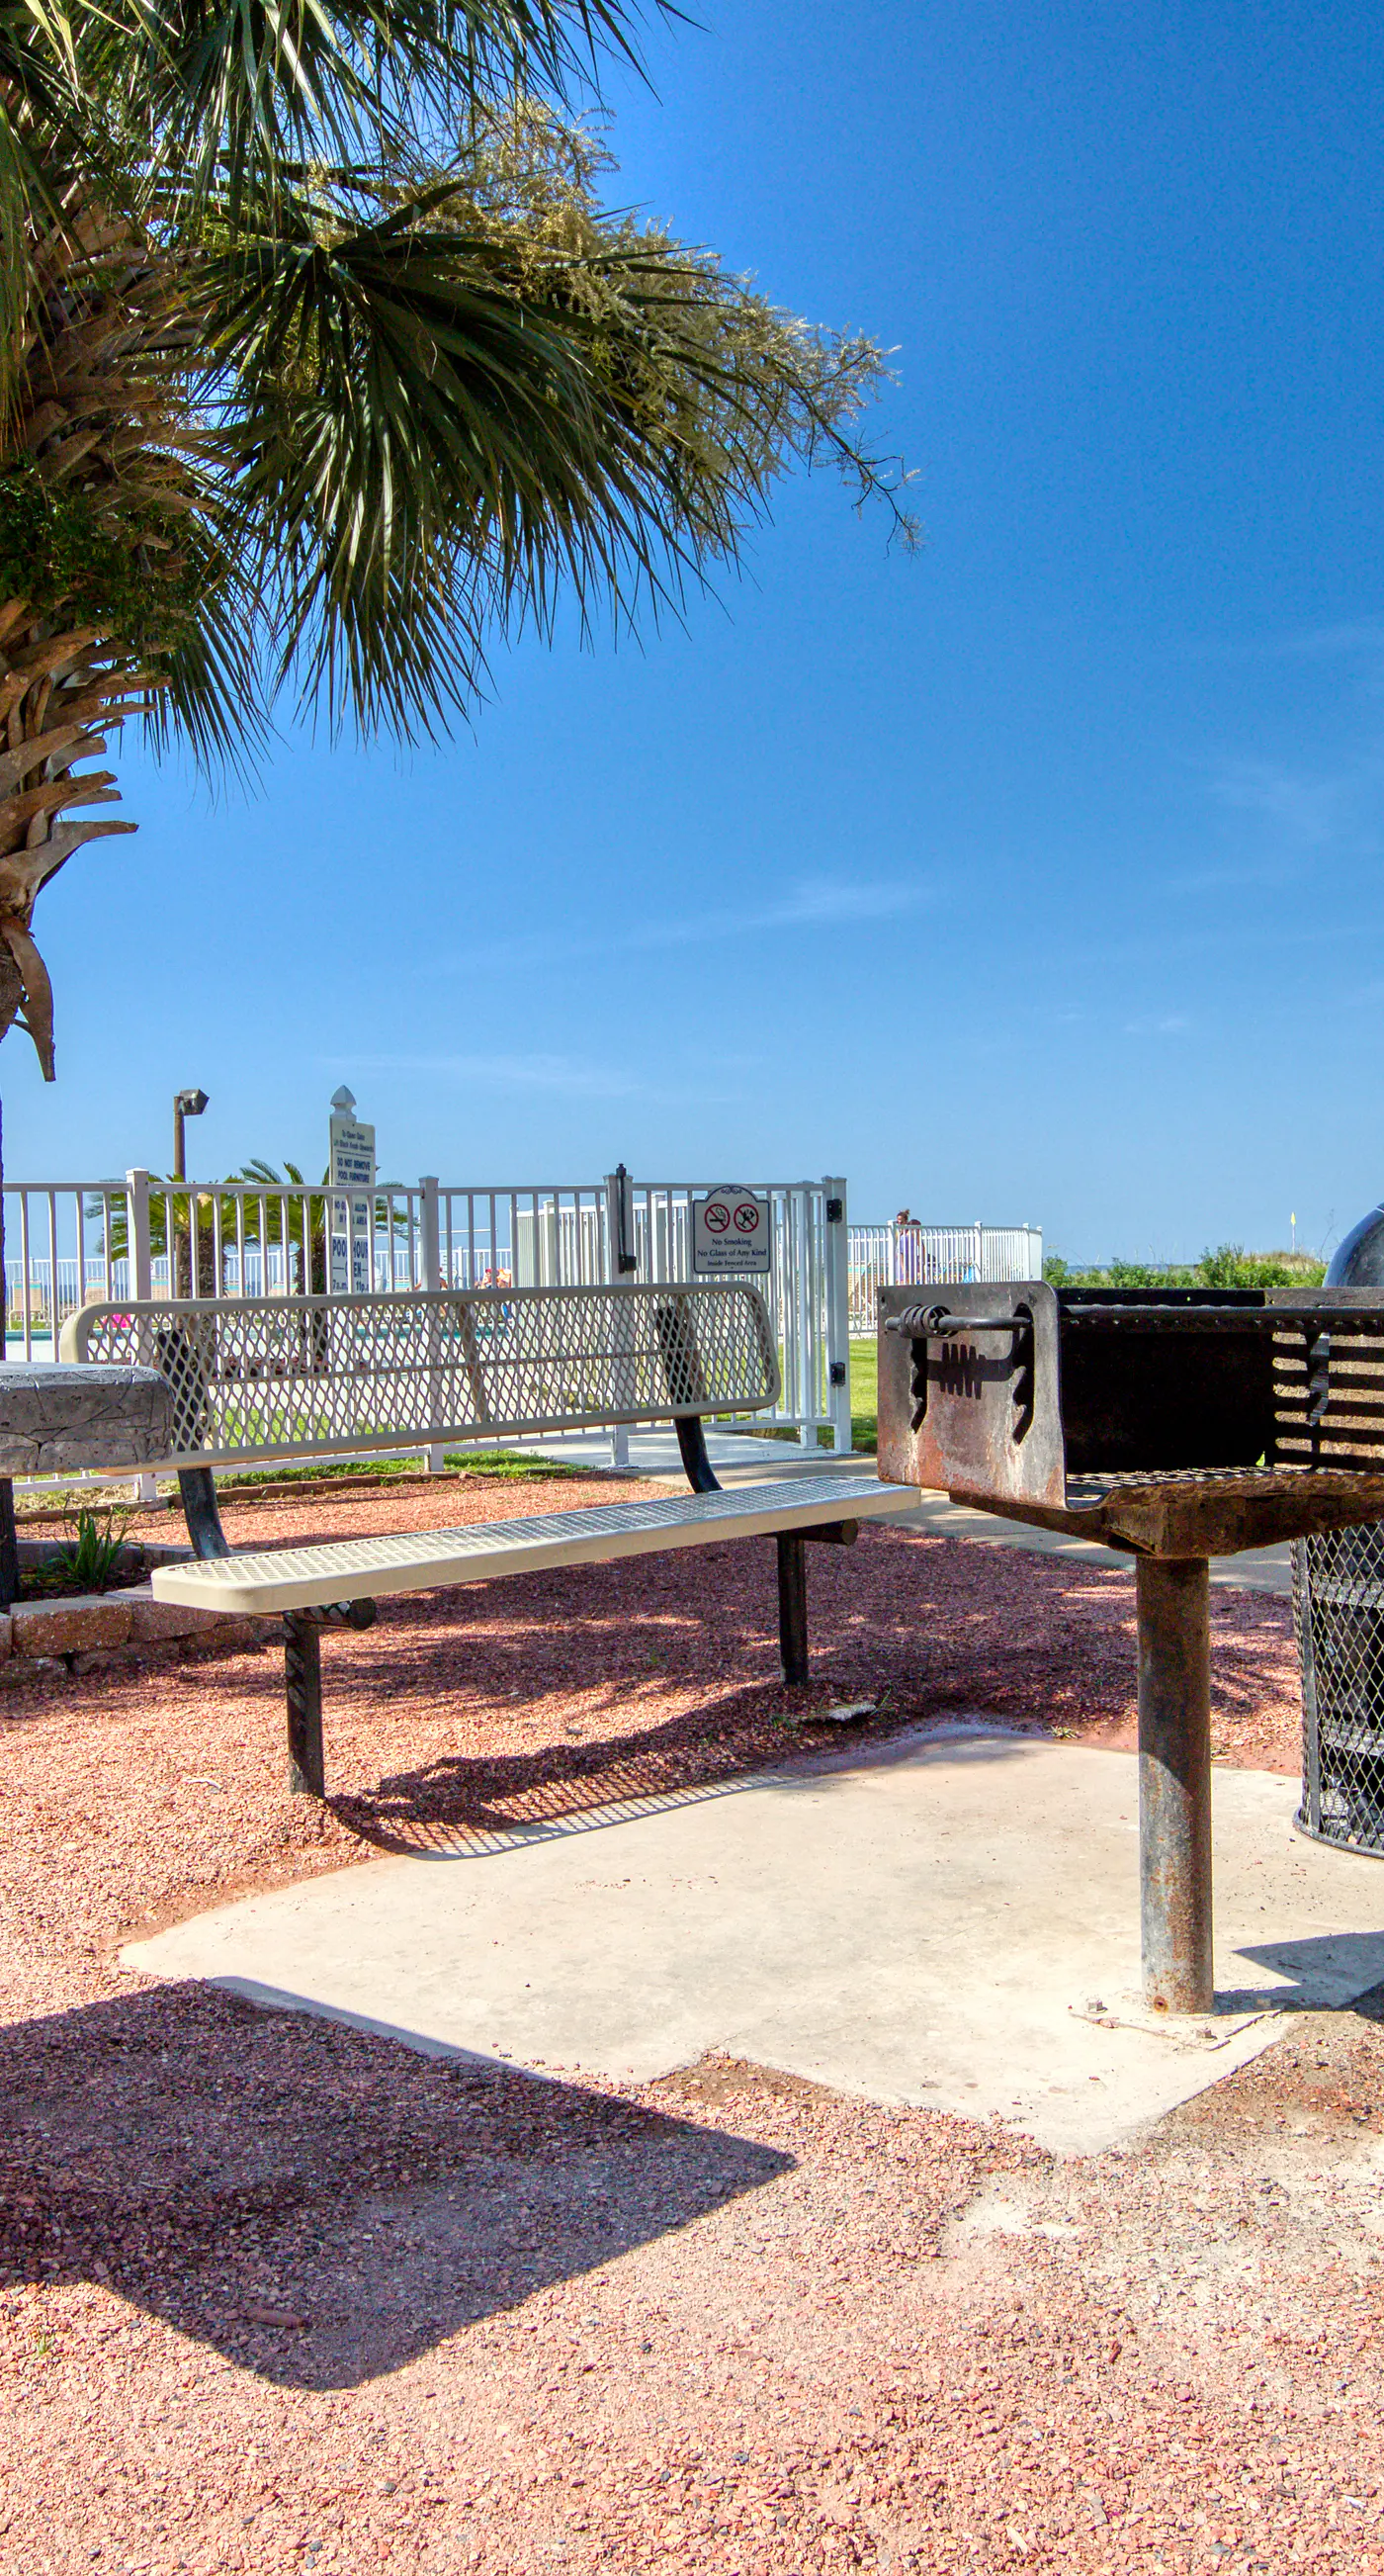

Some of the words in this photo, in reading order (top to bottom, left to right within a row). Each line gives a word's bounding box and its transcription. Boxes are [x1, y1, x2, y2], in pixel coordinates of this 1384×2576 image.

[337, 1156, 343, 1167] DO
[354, 1159, 370, 1171] REMOVE
[338, 1170, 348, 1181] POOL
[349, 1172, 370, 1184] FURNITURE
[724, 1238, 752, 1247] Smoking
